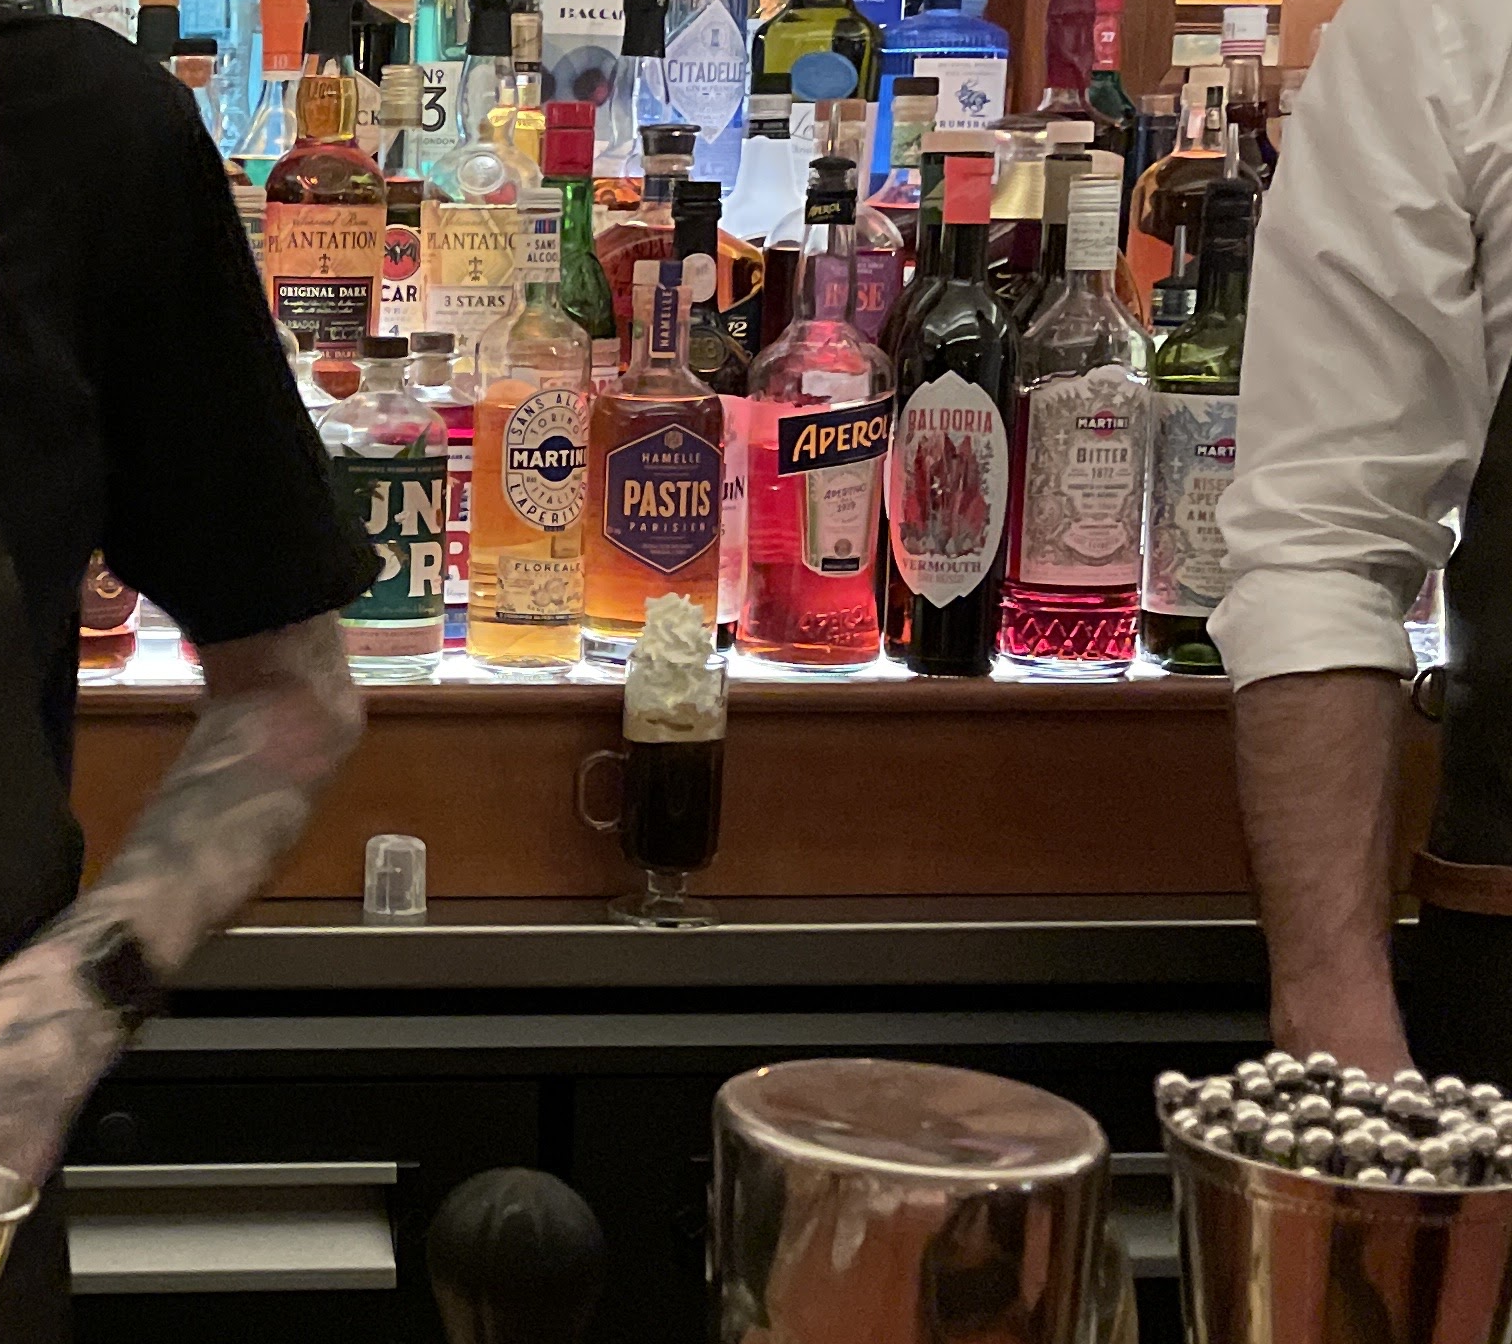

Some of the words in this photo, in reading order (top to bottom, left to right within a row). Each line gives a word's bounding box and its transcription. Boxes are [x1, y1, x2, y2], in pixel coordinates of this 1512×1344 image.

[667, 58, 746, 83] CITADELLE
[422, 86, 447, 132] 3
[268, 230, 378, 254] PLANTATION
[526, 251, 559, 263] ALCOO
[279, 286, 336, 298] ORIGINAL
[339, 286, 368, 298] DARK
[380, 284, 419, 303] CAR
[456, 294, 506, 308] STARS
[510, 397, 546, 437] SANS
[907, 408, 994, 435] BALDORIA
[1076, 417, 1129, 429] MARTINI
[641, 452, 702, 464] HAMELLE
[1076, 447, 1128, 464] BITTER
[623, 478, 712, 518] PASTIS
[514, 562, 581, 573] FLOREALE
[902, 557, 982, 574] VERMOUTH
